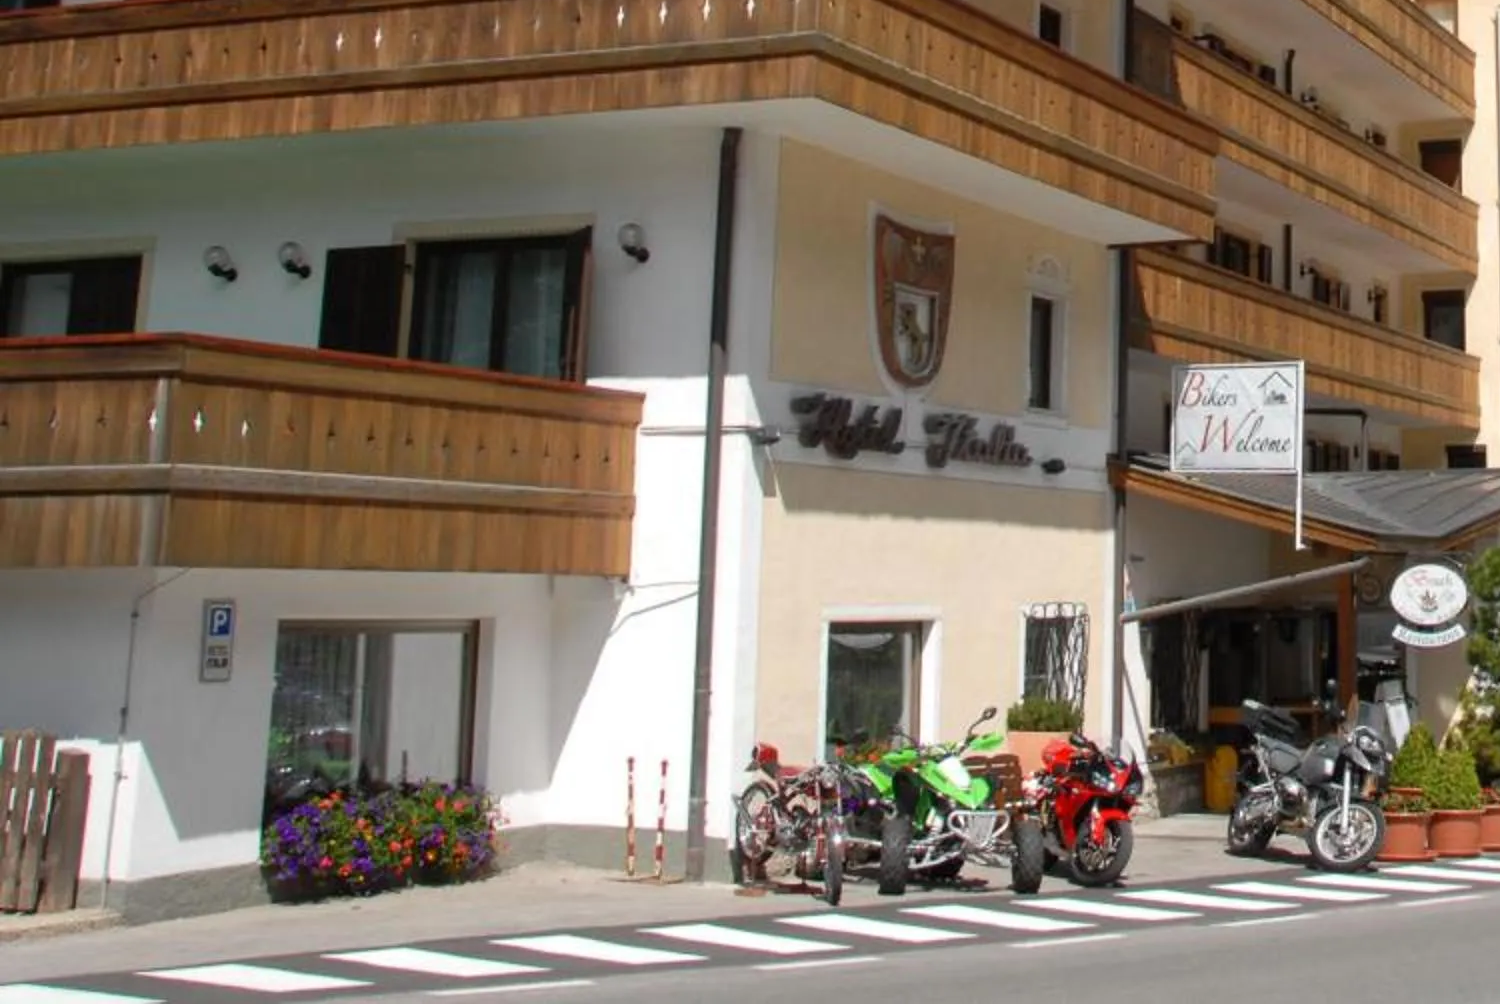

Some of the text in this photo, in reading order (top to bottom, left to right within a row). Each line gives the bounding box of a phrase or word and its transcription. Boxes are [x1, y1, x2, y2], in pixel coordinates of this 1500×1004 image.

[1181, 371, 1238, 407] Bikers
[790, 392, 1035, 469] Hotel Italia
[1200, 409, 1291, 452] Welcome
[212, 609, 228, 634] P
